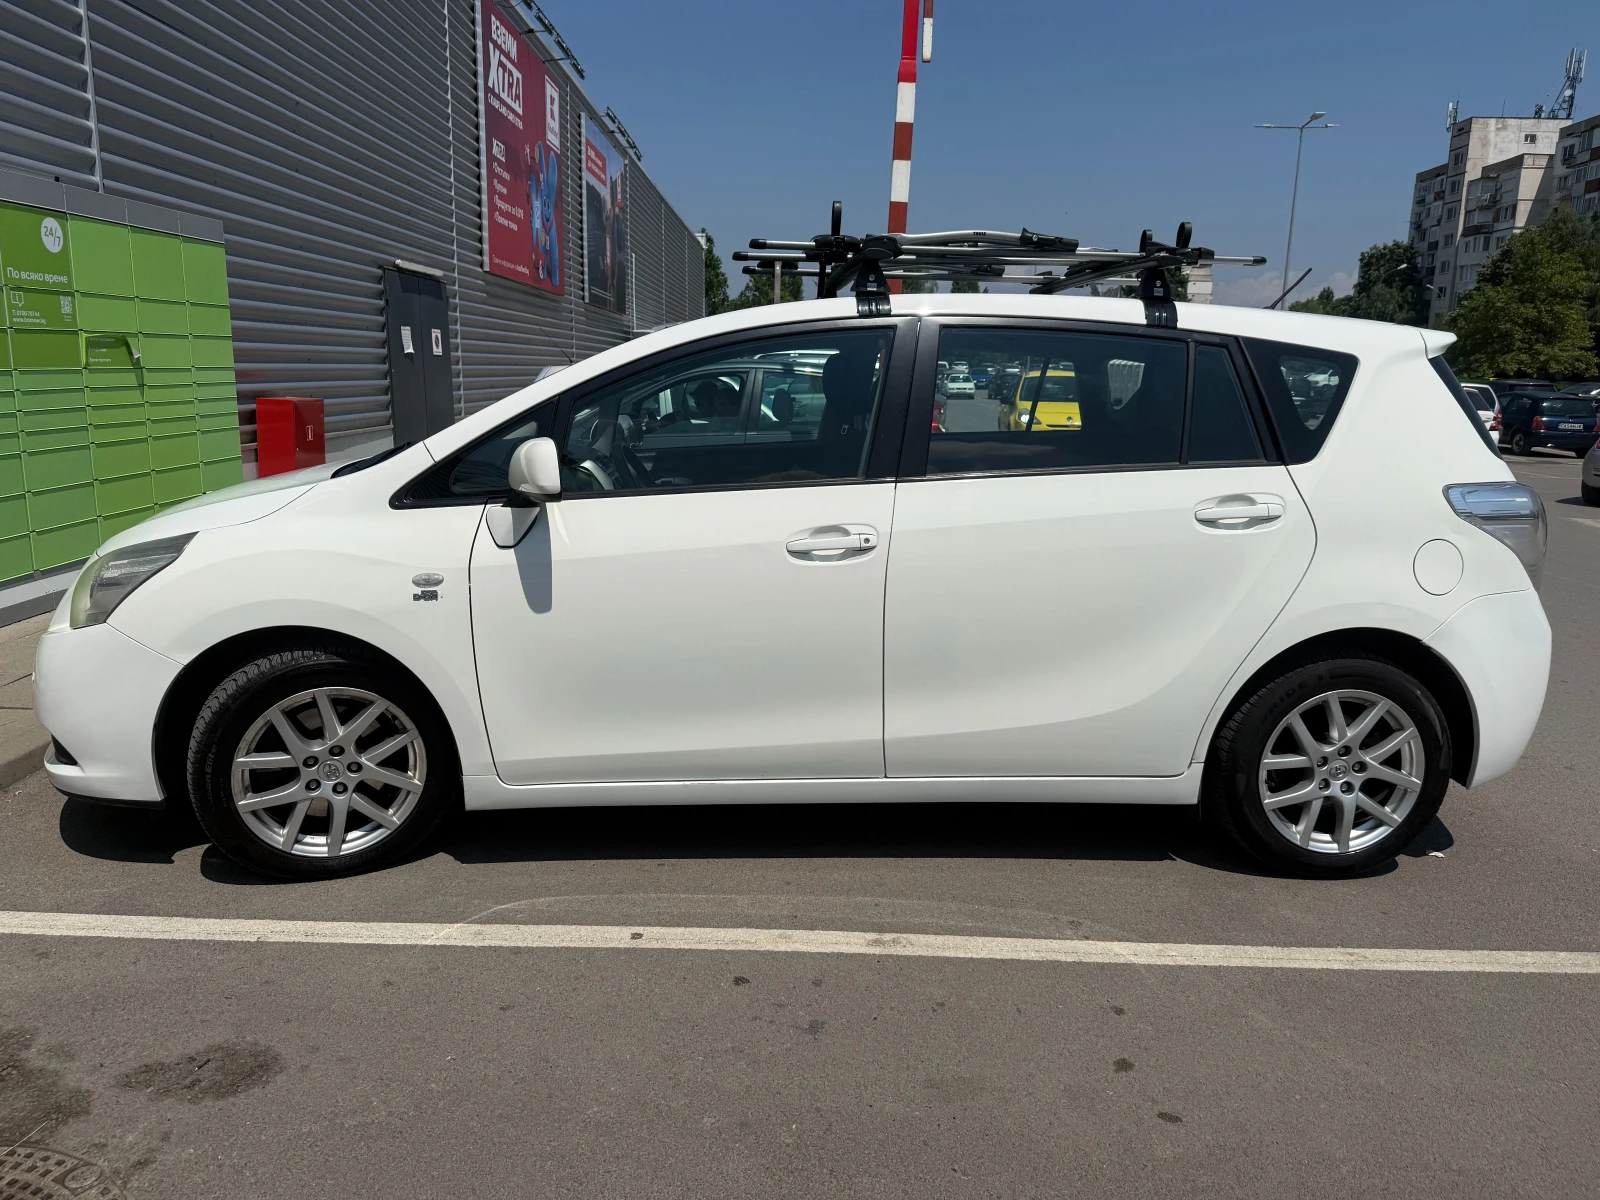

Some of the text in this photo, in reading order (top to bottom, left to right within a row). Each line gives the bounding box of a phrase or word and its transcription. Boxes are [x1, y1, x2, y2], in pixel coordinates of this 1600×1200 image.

[491, 13, 517, 63] ВЗЕМИ
[488, 41, 522, 116] XTRA
[43, 225, 61, 247] 24/7
[7, 267, 68, 285] По всяко време
